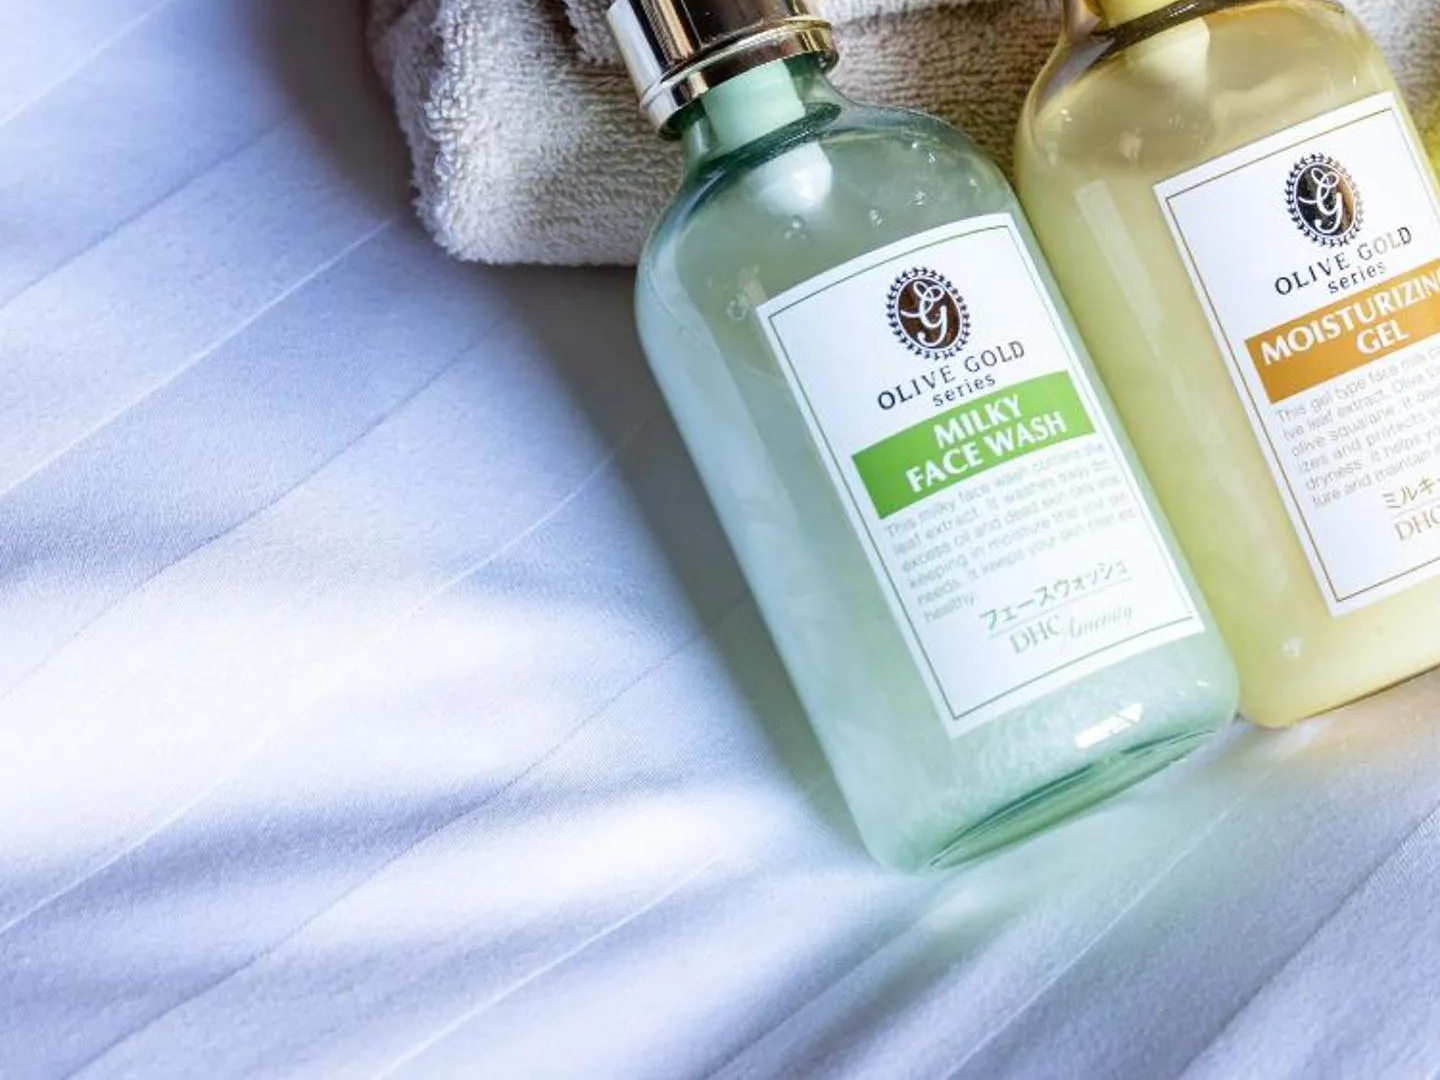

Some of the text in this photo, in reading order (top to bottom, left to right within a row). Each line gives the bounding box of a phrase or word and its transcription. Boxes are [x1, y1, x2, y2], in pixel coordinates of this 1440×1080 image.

[1274, 225, 1413, 296] OLIVE GOLD
[1327, 260, 1387, 295] series
[1357, 319, 1409, 355] GEL
[877, 340, 1026, 411] OLIVE GOLD
[933, 372, 996, 408] series
[933, 393, 1025, 449] MILKY
[1275, 401, 1306, 423] This
[1307, 390, 1335, 412] gel
[905, 442, 981, 493] FACE
[985, 410, 1068, 457] WASH
[1331, 437, 1362, 459] and
[957, 481, 991, 503] face
[1010, 616, 1062, 656] DHC
